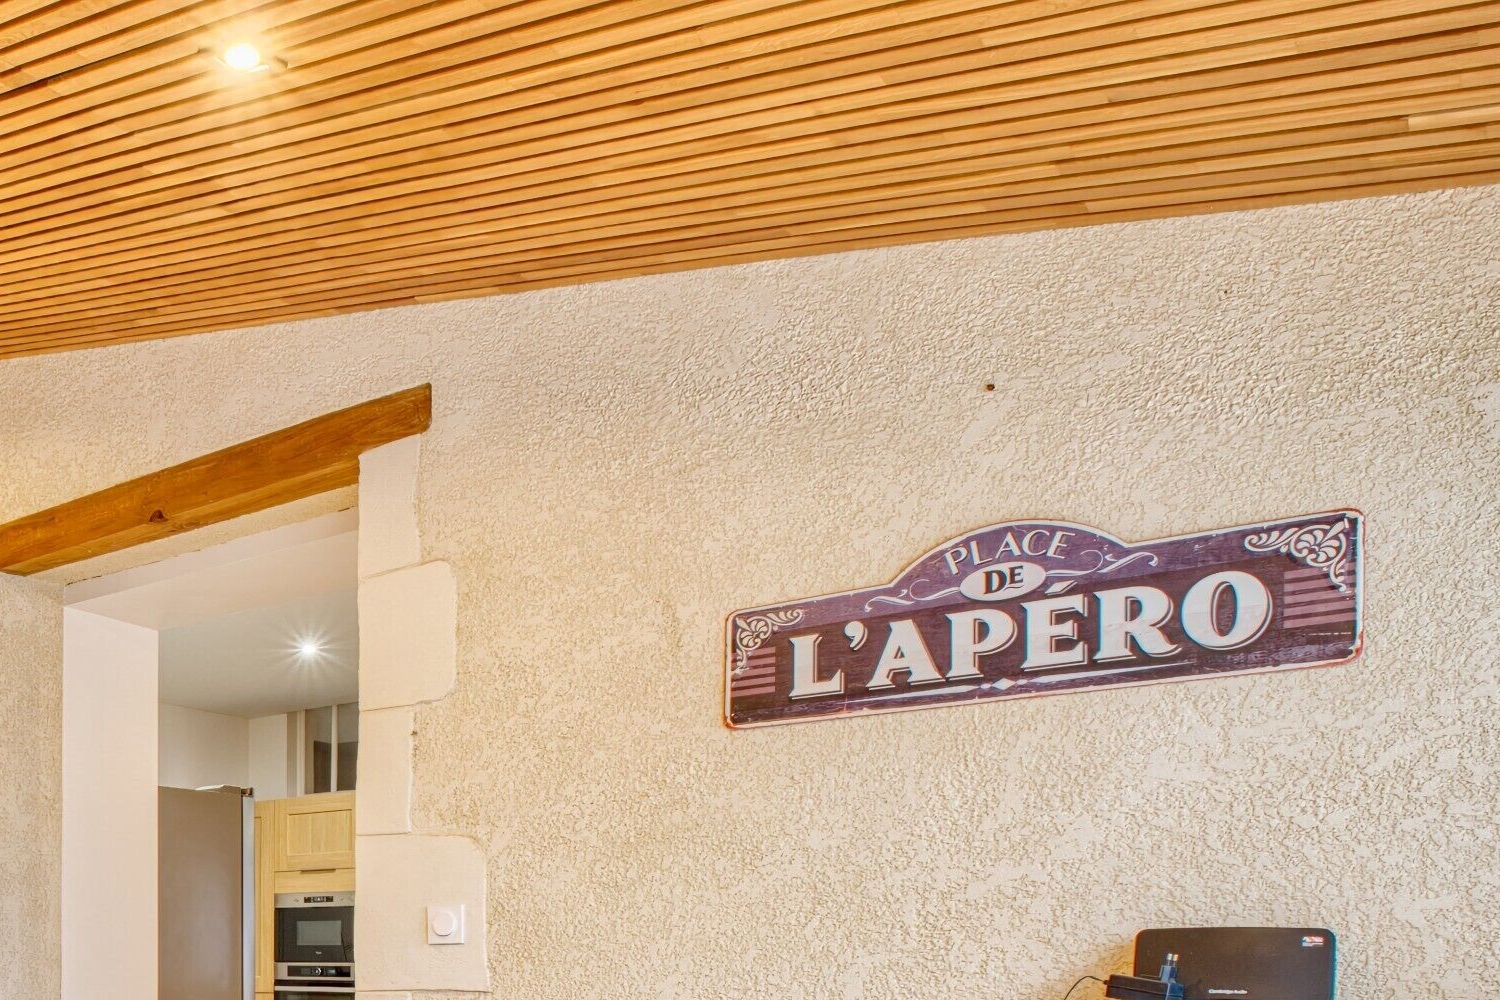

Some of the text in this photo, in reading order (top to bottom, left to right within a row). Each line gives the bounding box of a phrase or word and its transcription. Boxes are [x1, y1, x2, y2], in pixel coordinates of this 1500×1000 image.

[945, 529, 1075, 575] PLACE
[982, 565, 1024, 594] DE
[788, 571, 1274, 699] L'APÉRO
